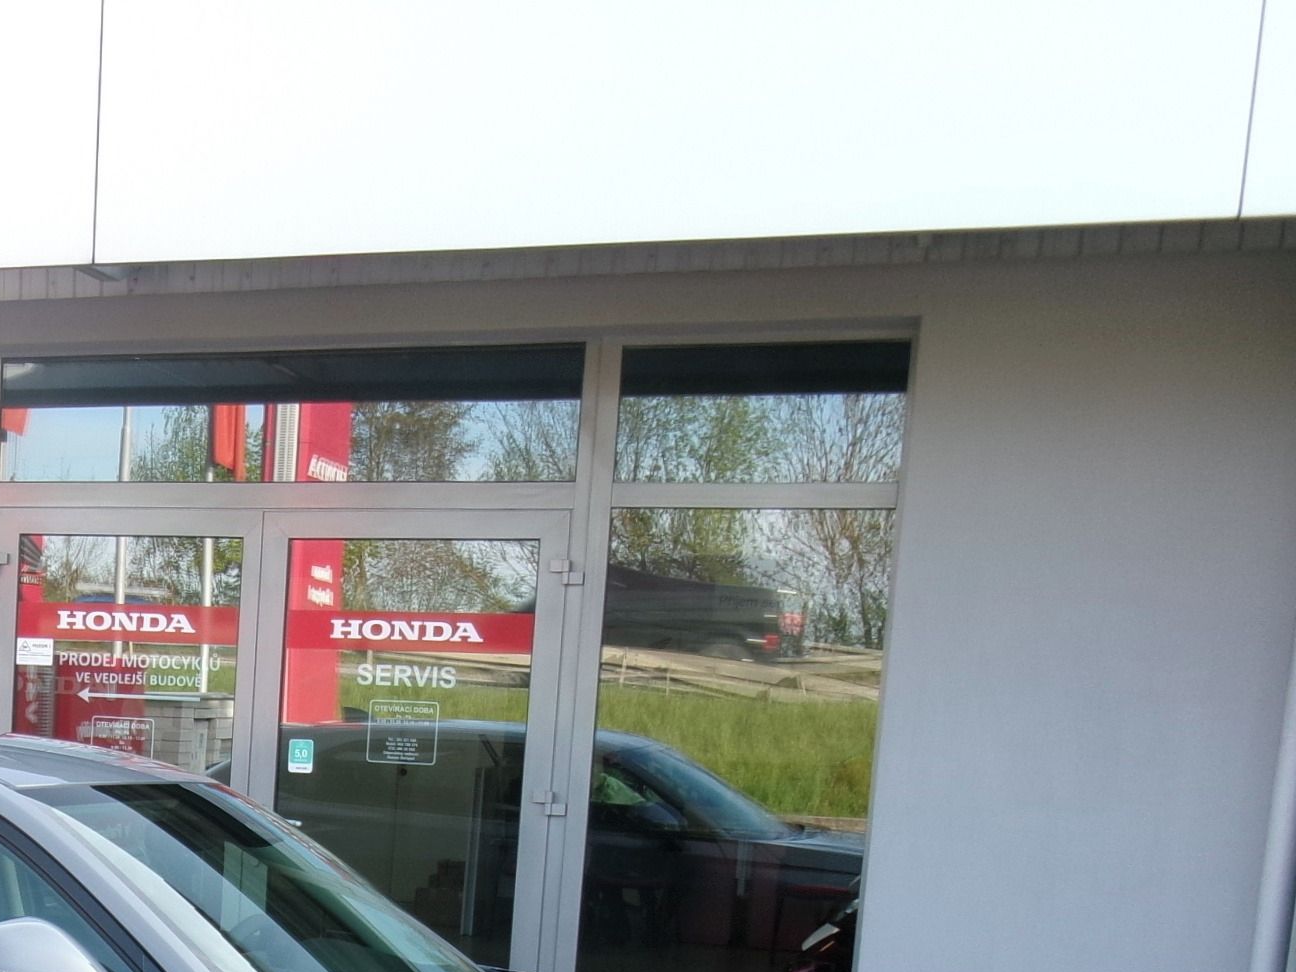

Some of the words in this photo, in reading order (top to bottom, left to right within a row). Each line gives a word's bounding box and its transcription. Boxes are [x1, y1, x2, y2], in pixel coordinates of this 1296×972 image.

[57, 610, 196, 634] HONDA
[330, 619, 484, 643] HONDA
[59, 652, 117, 668] PRODEJ
[122, 652, 221, 671] MOTOCYKŮ
[76, 672, 91, 683] VE
[94, 670, 147, 685] VEDLEJŠÍ
[150, 673, 201, 688] BUDOVĚ
[357, 664, 457, 688] SERVIS
